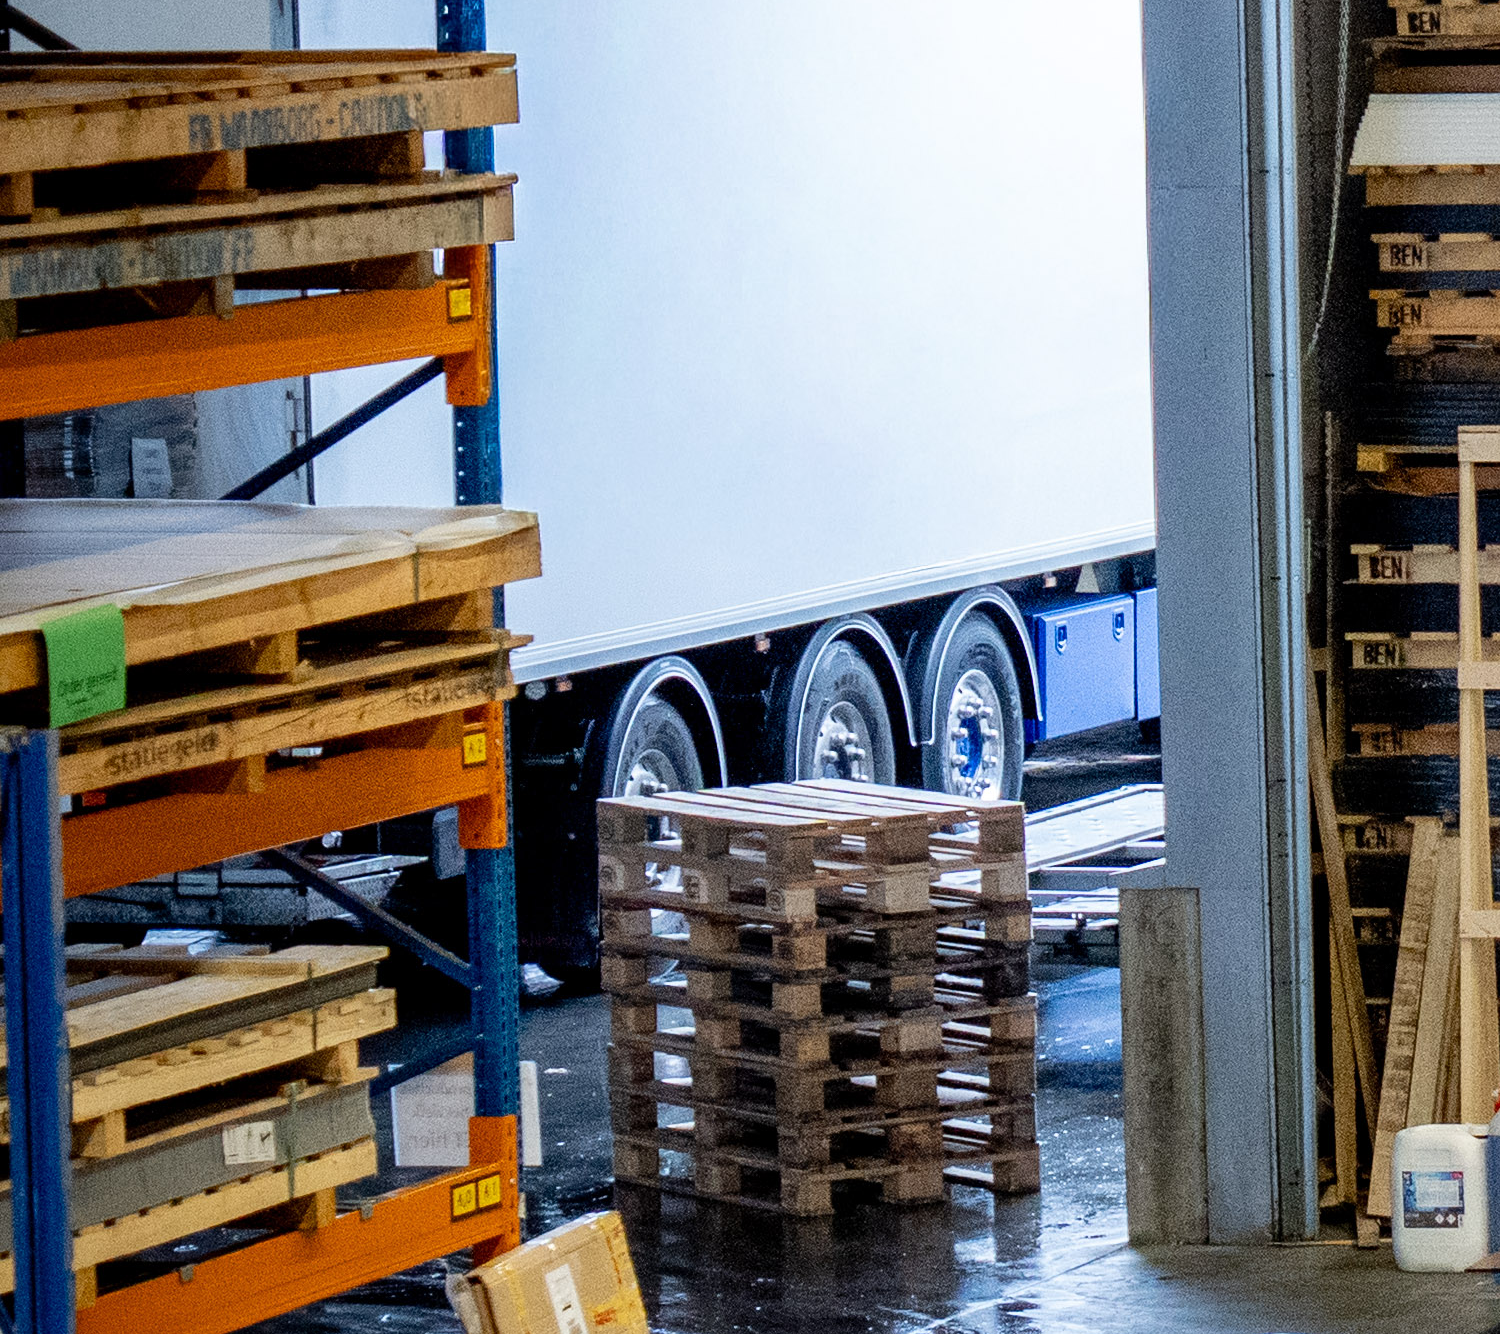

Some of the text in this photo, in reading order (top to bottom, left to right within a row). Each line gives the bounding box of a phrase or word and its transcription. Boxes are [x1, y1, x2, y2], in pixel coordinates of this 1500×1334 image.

[1407, 11, 1442, 34] BEN
[1389, 243, 1423, 267] BEN
[1388, 303, 1422, 327] BEN
[1369, 554, 1403, 579] BEN
[1363, 642, 1397, 667] BEN
